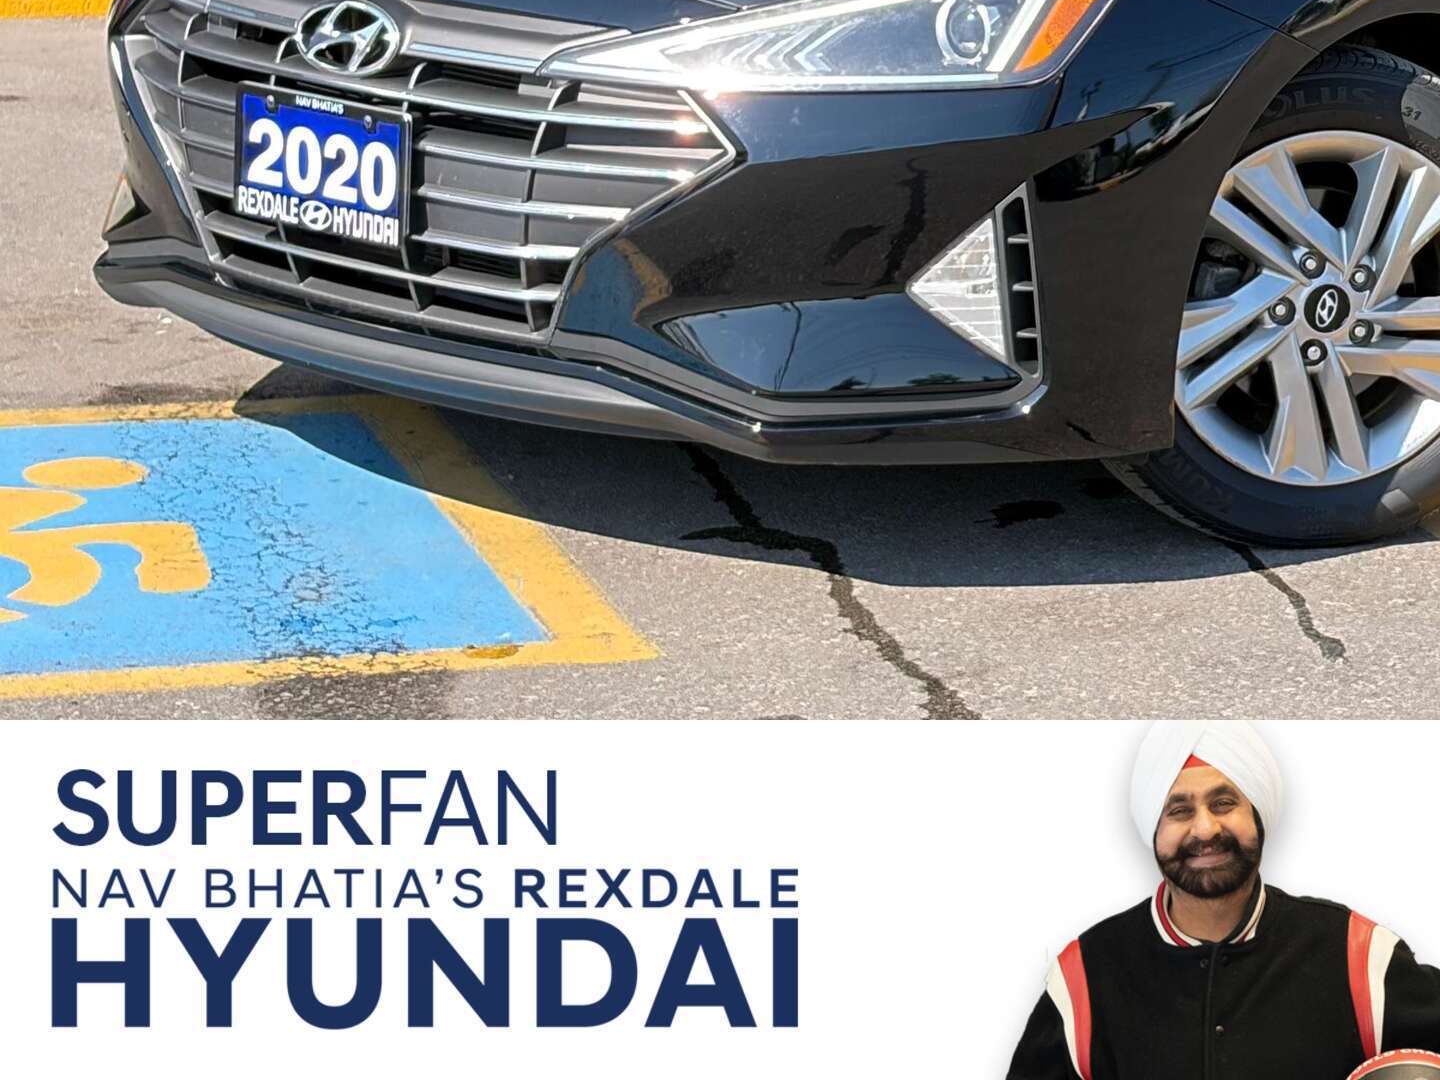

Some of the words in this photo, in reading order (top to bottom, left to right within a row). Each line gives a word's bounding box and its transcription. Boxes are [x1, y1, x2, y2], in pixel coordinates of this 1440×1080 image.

[296, 95, 312, 108] NAV
[247, 118, 397, 212] 2020
[238, 186, 300, 224] REXDALE
[332, 205, 399, 247] HYUNDAI
